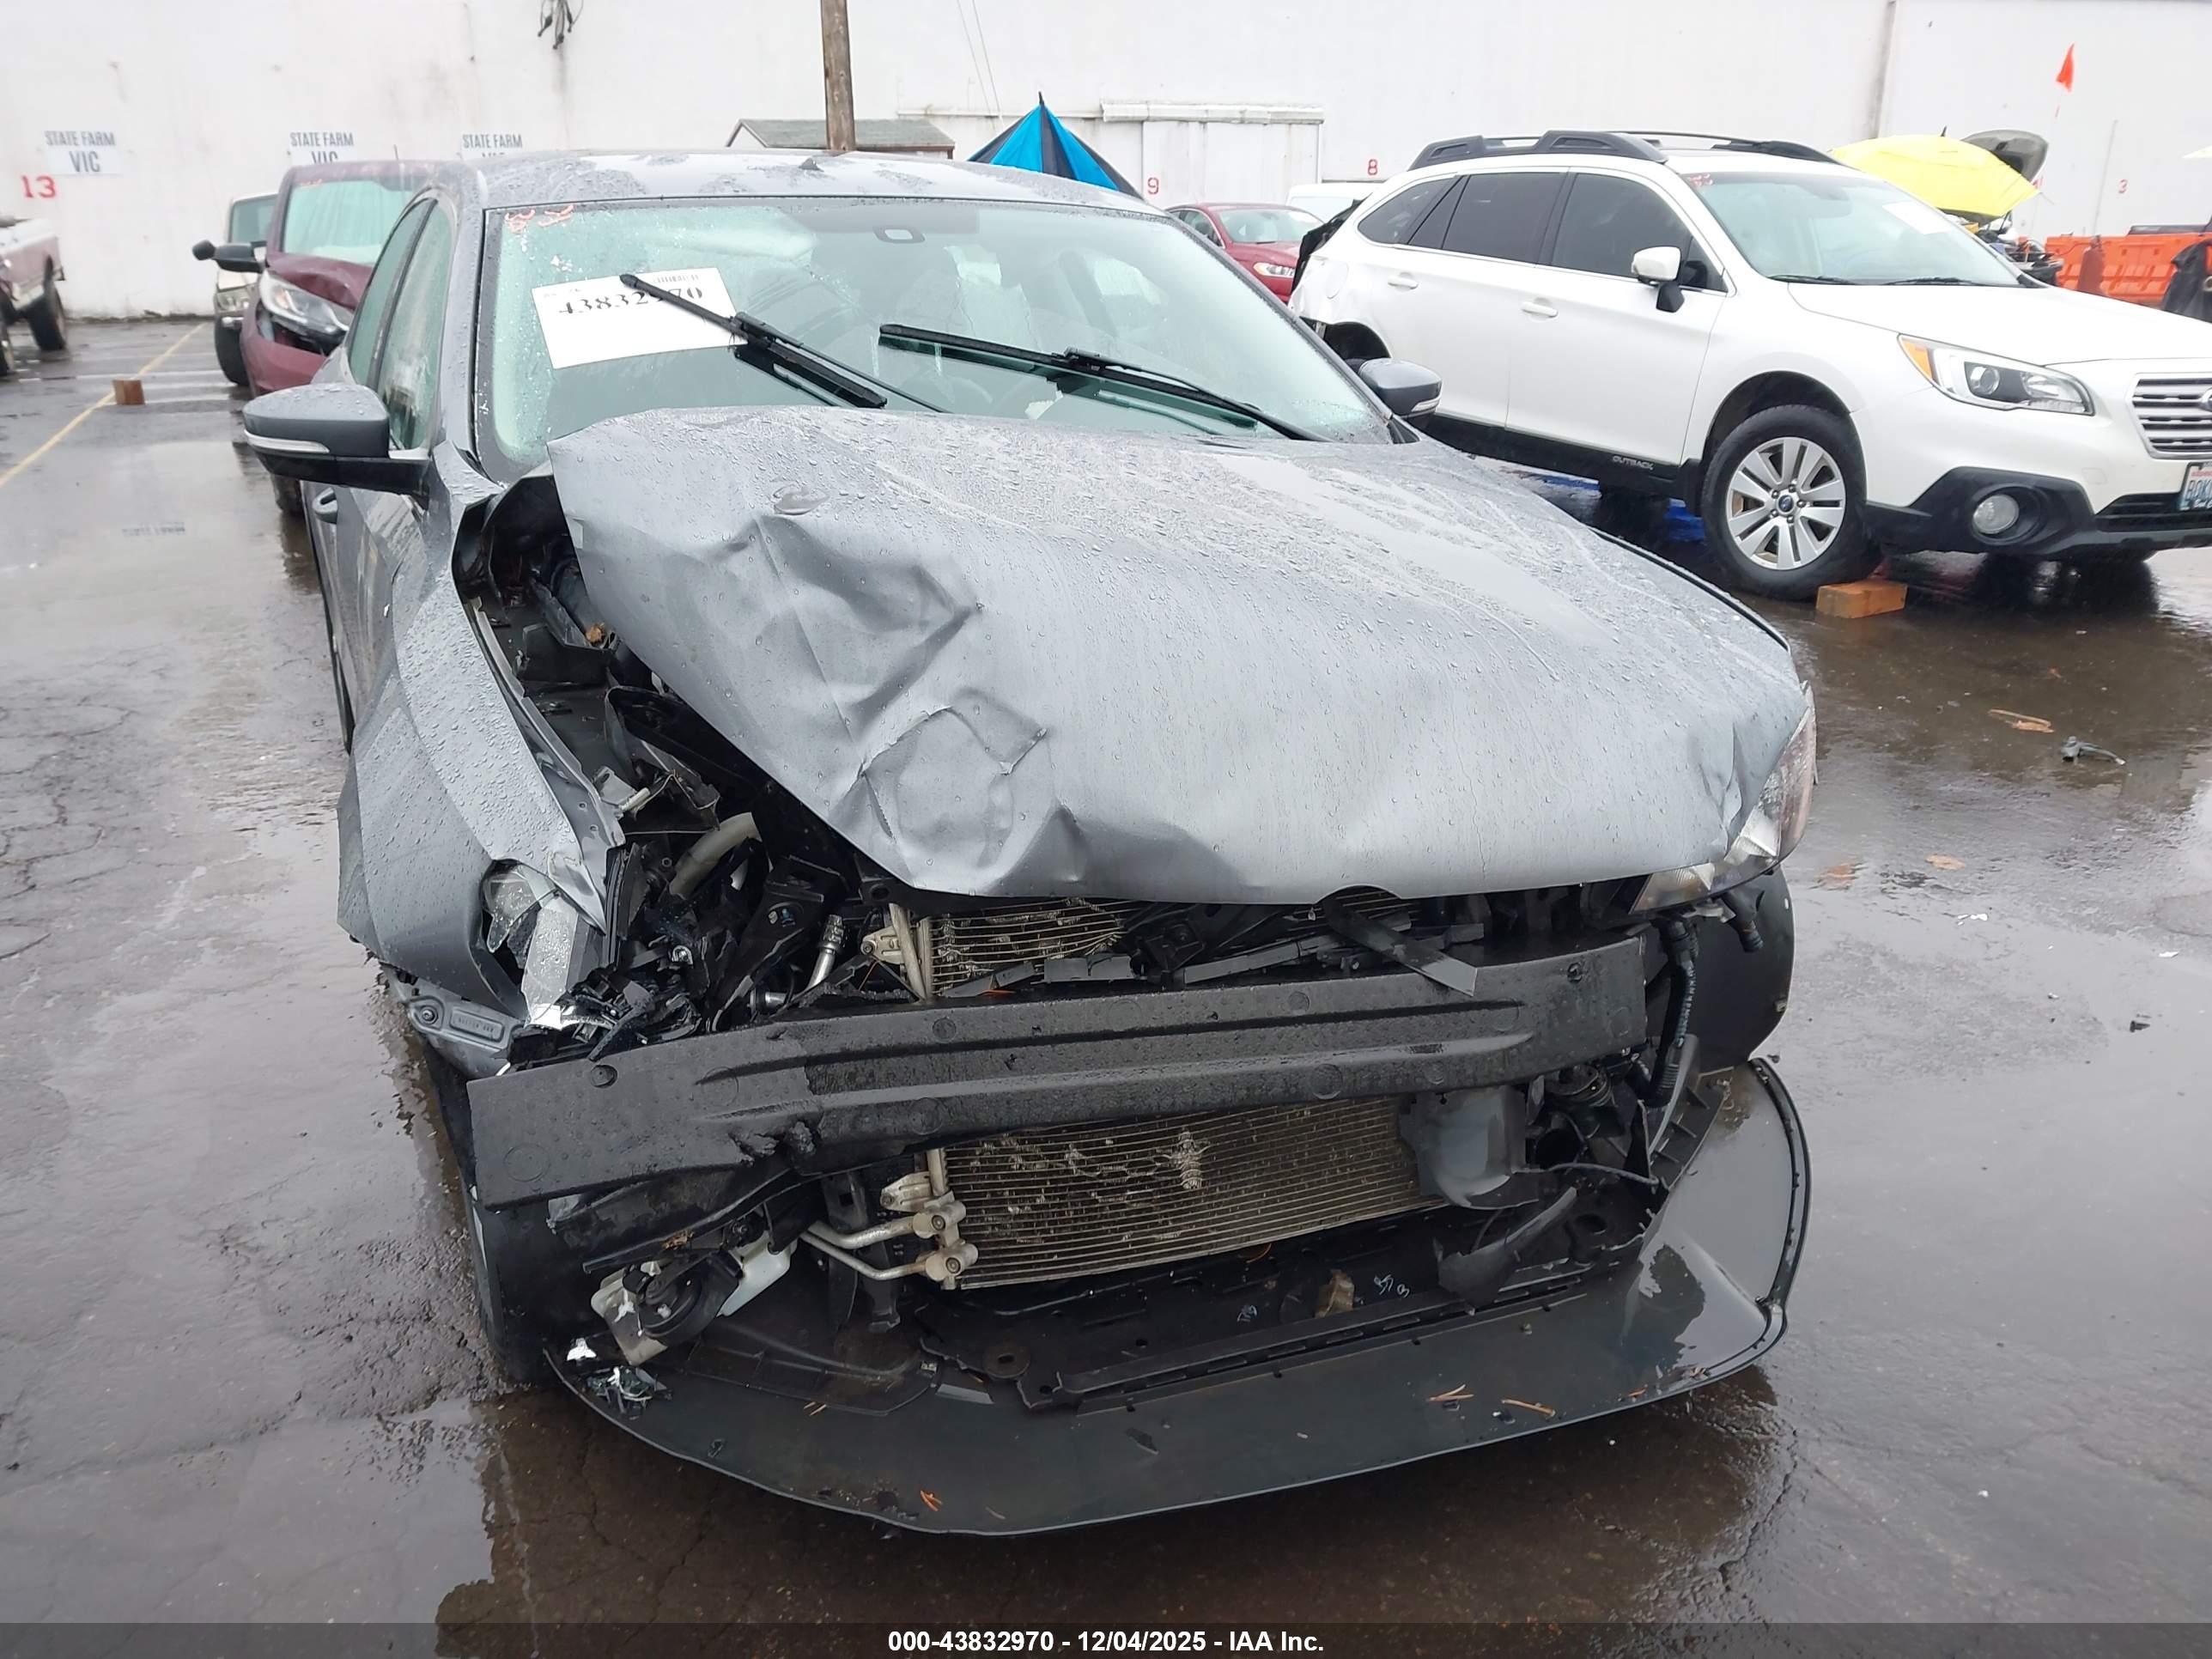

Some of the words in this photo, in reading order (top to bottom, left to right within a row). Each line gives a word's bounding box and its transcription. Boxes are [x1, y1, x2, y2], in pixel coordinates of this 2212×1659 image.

[44, 131, 79, 146] STATE
[81, 131, 115, 146] FARM
[289, 131, 320, 147] STATE
[322, 131, 354, 147] FARM
[462, 133, 491, 149] STATE
[493, 133, 523, 149] FARM
[68, 150, 101, 173] VIC
[1367, 158, 1378, 176] 8
[21, 174, 57, 198] 13
[1147, 176, 1159, 195] 9
[2118, 179, 2128, 194] 3
[558, 287, 702, 314] 4383270
[1613, 455, 1654, 471] OUTBACK
